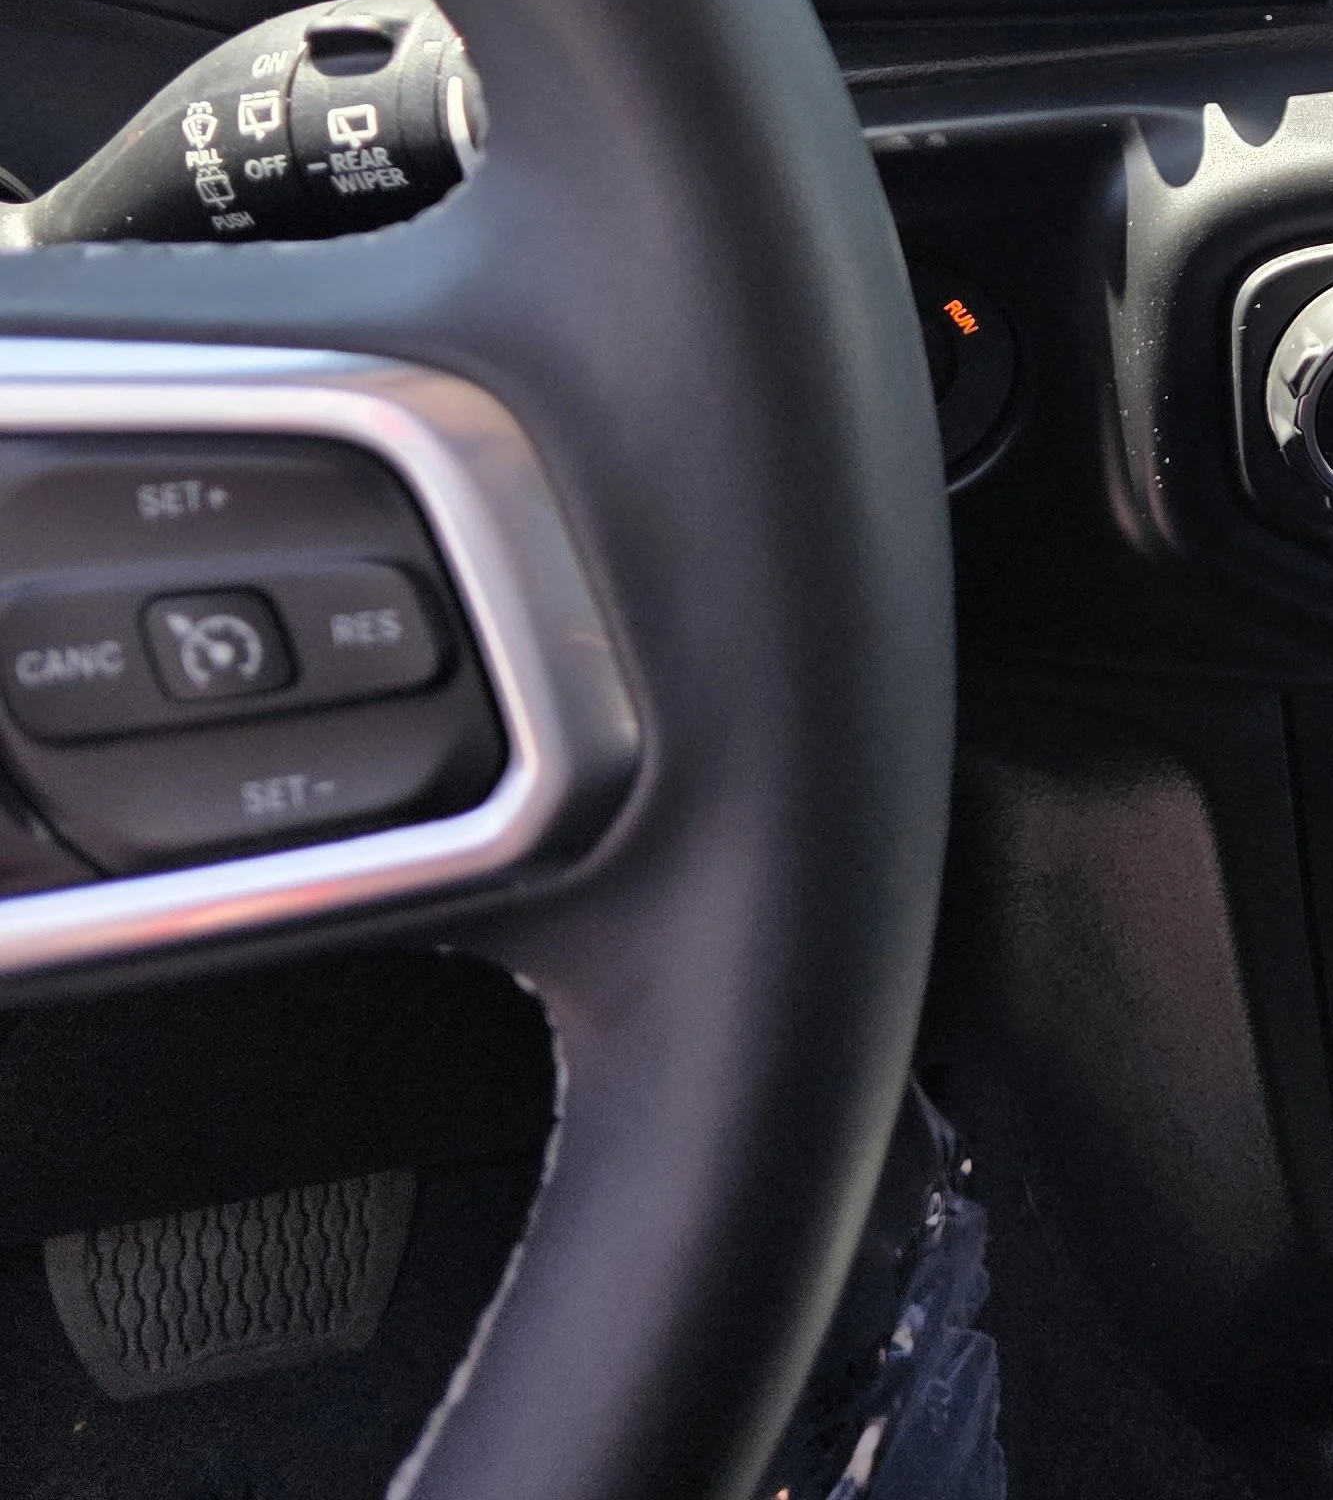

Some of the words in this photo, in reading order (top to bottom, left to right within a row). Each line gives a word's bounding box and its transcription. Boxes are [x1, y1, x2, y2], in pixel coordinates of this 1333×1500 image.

[252, 50, 288, 78] ON
[185, 148, 224, 171] PULL
[244, 155, 288, 181] OFF
[329, 147, 393, 174] REAR
[331, 168, 409, 194] WIPER
[211, 211, 256, 233] PUSH
[943, 299, 980, 336] RUN
[330, 608, 401, 648] RES
[15, 641, 124, 687] CANC
